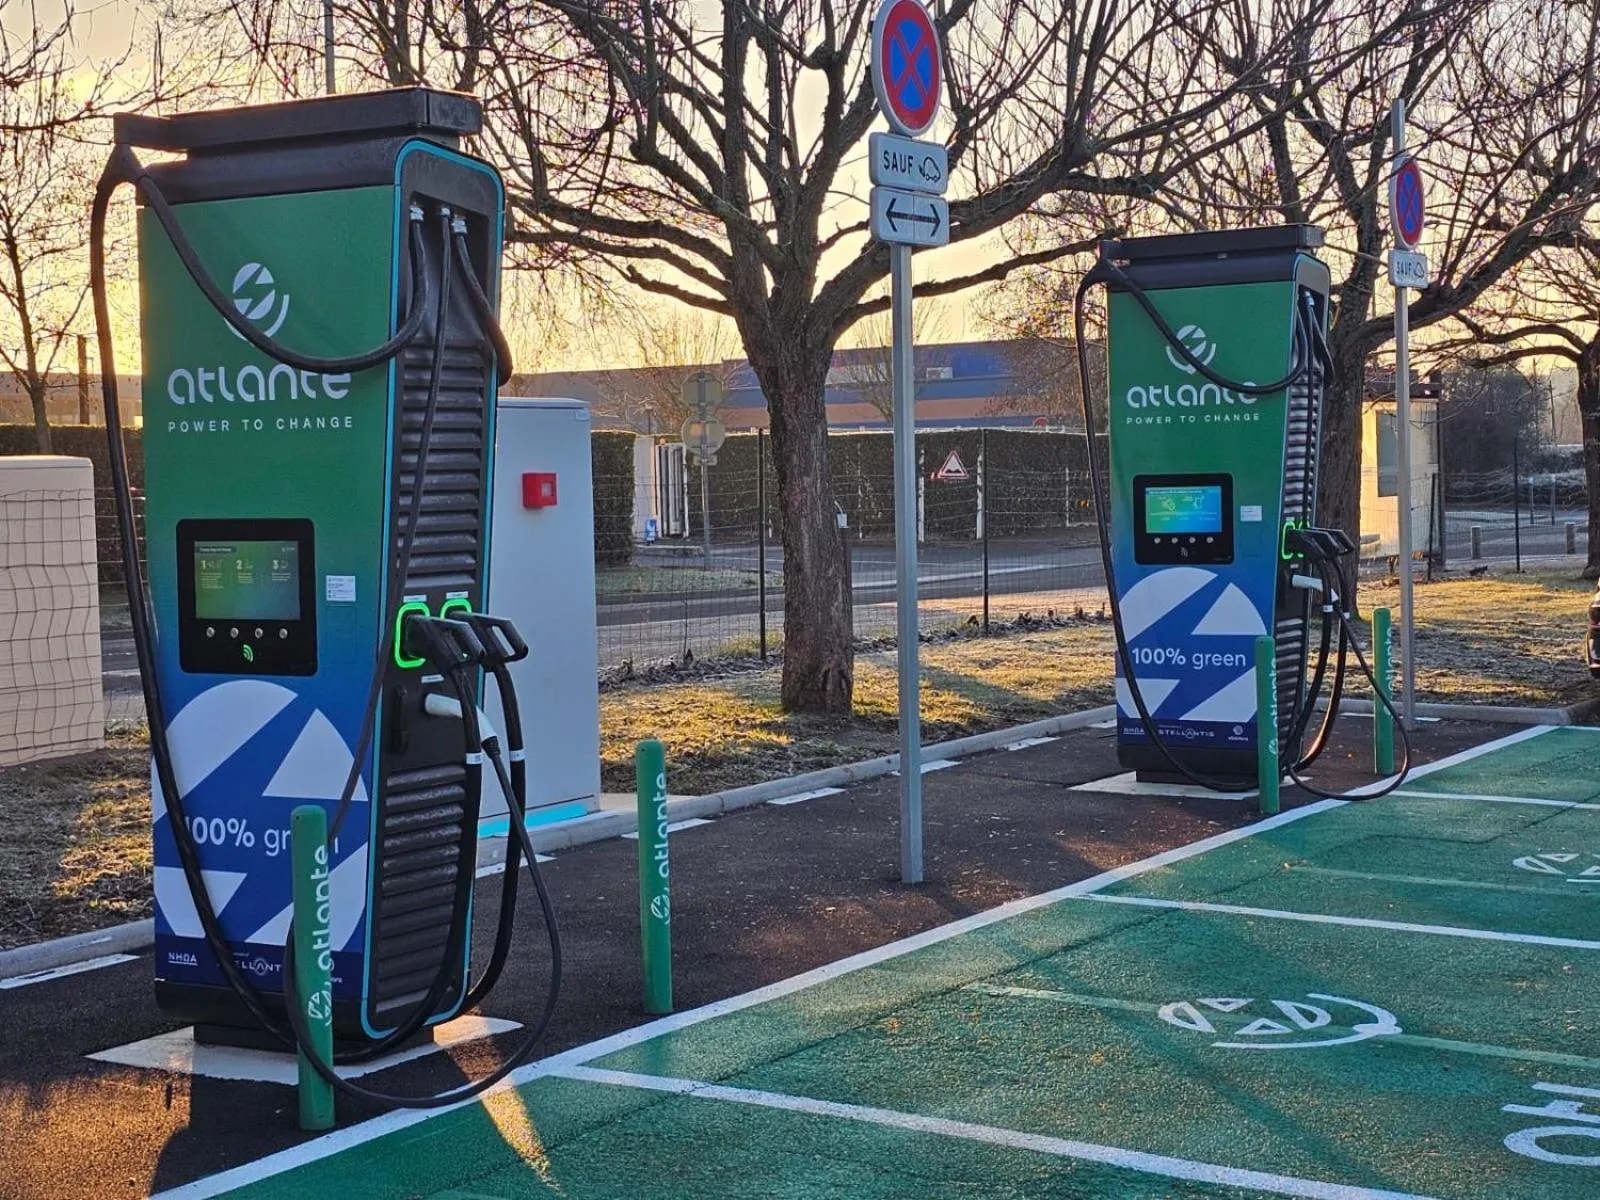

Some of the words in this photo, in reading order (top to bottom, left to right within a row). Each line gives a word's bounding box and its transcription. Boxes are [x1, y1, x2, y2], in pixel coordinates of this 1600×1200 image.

[883, 150, 914, 176] SAUF
[1396, 260, 1412, 276] SAUF
[167, 363, 352, 405] atlante
[168, 419, 230, 433] POWER
[241, 418, 265, 432] TO
[275, 415, 354, 431] CHANGE
[1126, 416, 1172, 425] POWER
[1180, 415, 1197, 424] TO
[1203, 413, 1261, 423] CHANGE
[236, 559, 243, 570] 2
[1132, 647, 1187, 665] 100%
[1192, 653, 1247, 670] green
[652, 772, 670, 879] atlante
[310, 844, 335, 971] atlante
[168, 951, 198, 963] NHOA
